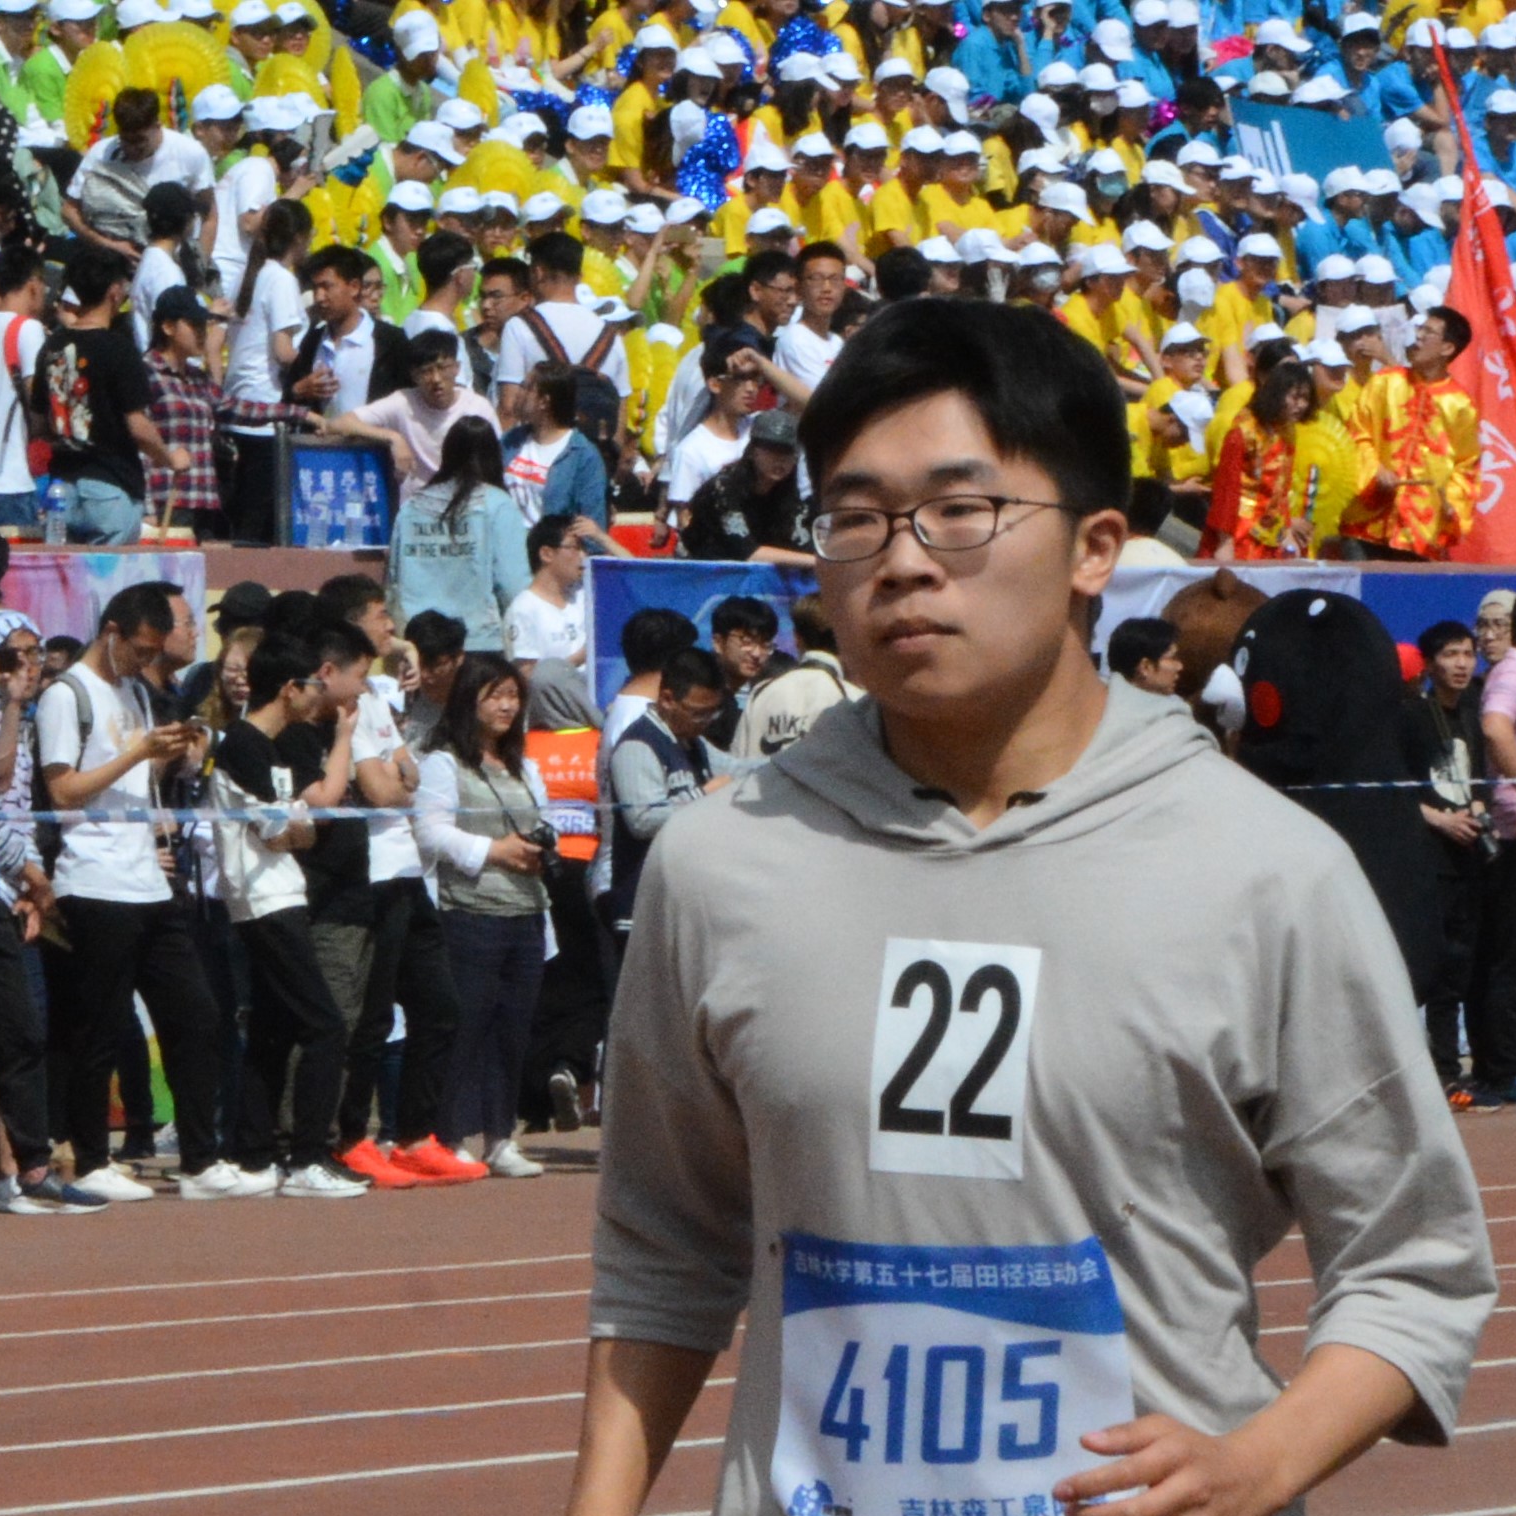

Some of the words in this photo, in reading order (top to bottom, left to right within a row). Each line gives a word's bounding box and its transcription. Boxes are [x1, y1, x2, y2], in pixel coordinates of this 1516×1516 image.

[878, 958, 1022, 1141] 22
[795, 1251, 1100, 1289] 吉林大学第五十七届田径运动会
[820, 1340, 1062, 1464] 4105
